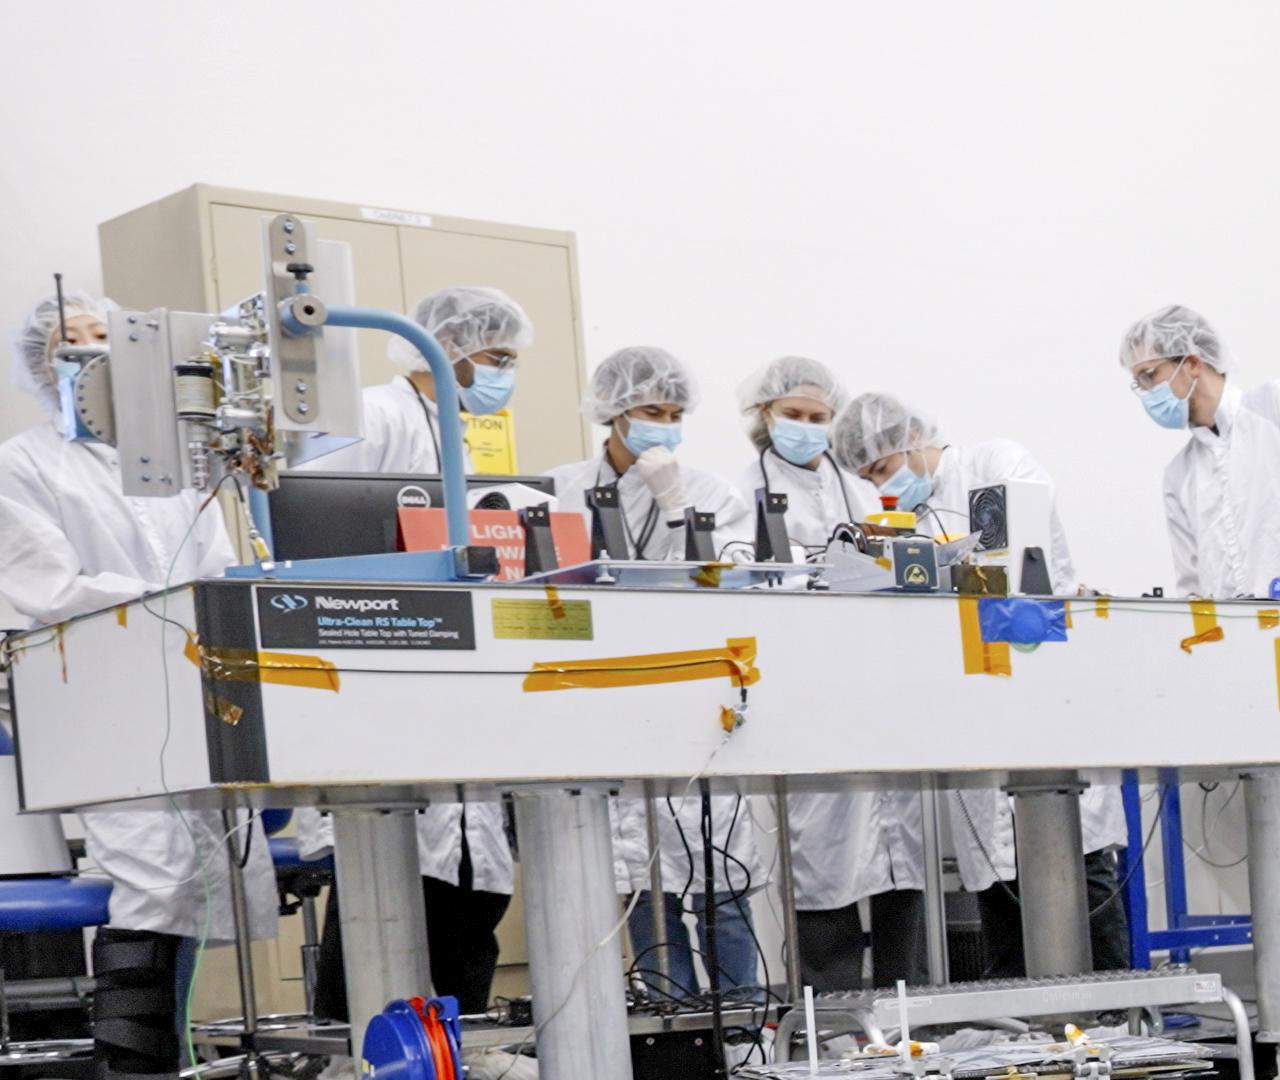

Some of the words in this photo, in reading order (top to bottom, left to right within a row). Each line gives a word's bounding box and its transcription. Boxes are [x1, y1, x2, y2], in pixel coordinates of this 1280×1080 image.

[467, 417, 503, 430] TION
[401, 495, 426, 504] DELL
[472, 525, 523, 540] LIGH
[315, 596, 399, 612] Newport
[317, 616, 373, 627] Ultra-Clean
[375, 616, 390, 627] RS
[391, 617, 416, 628] Table
